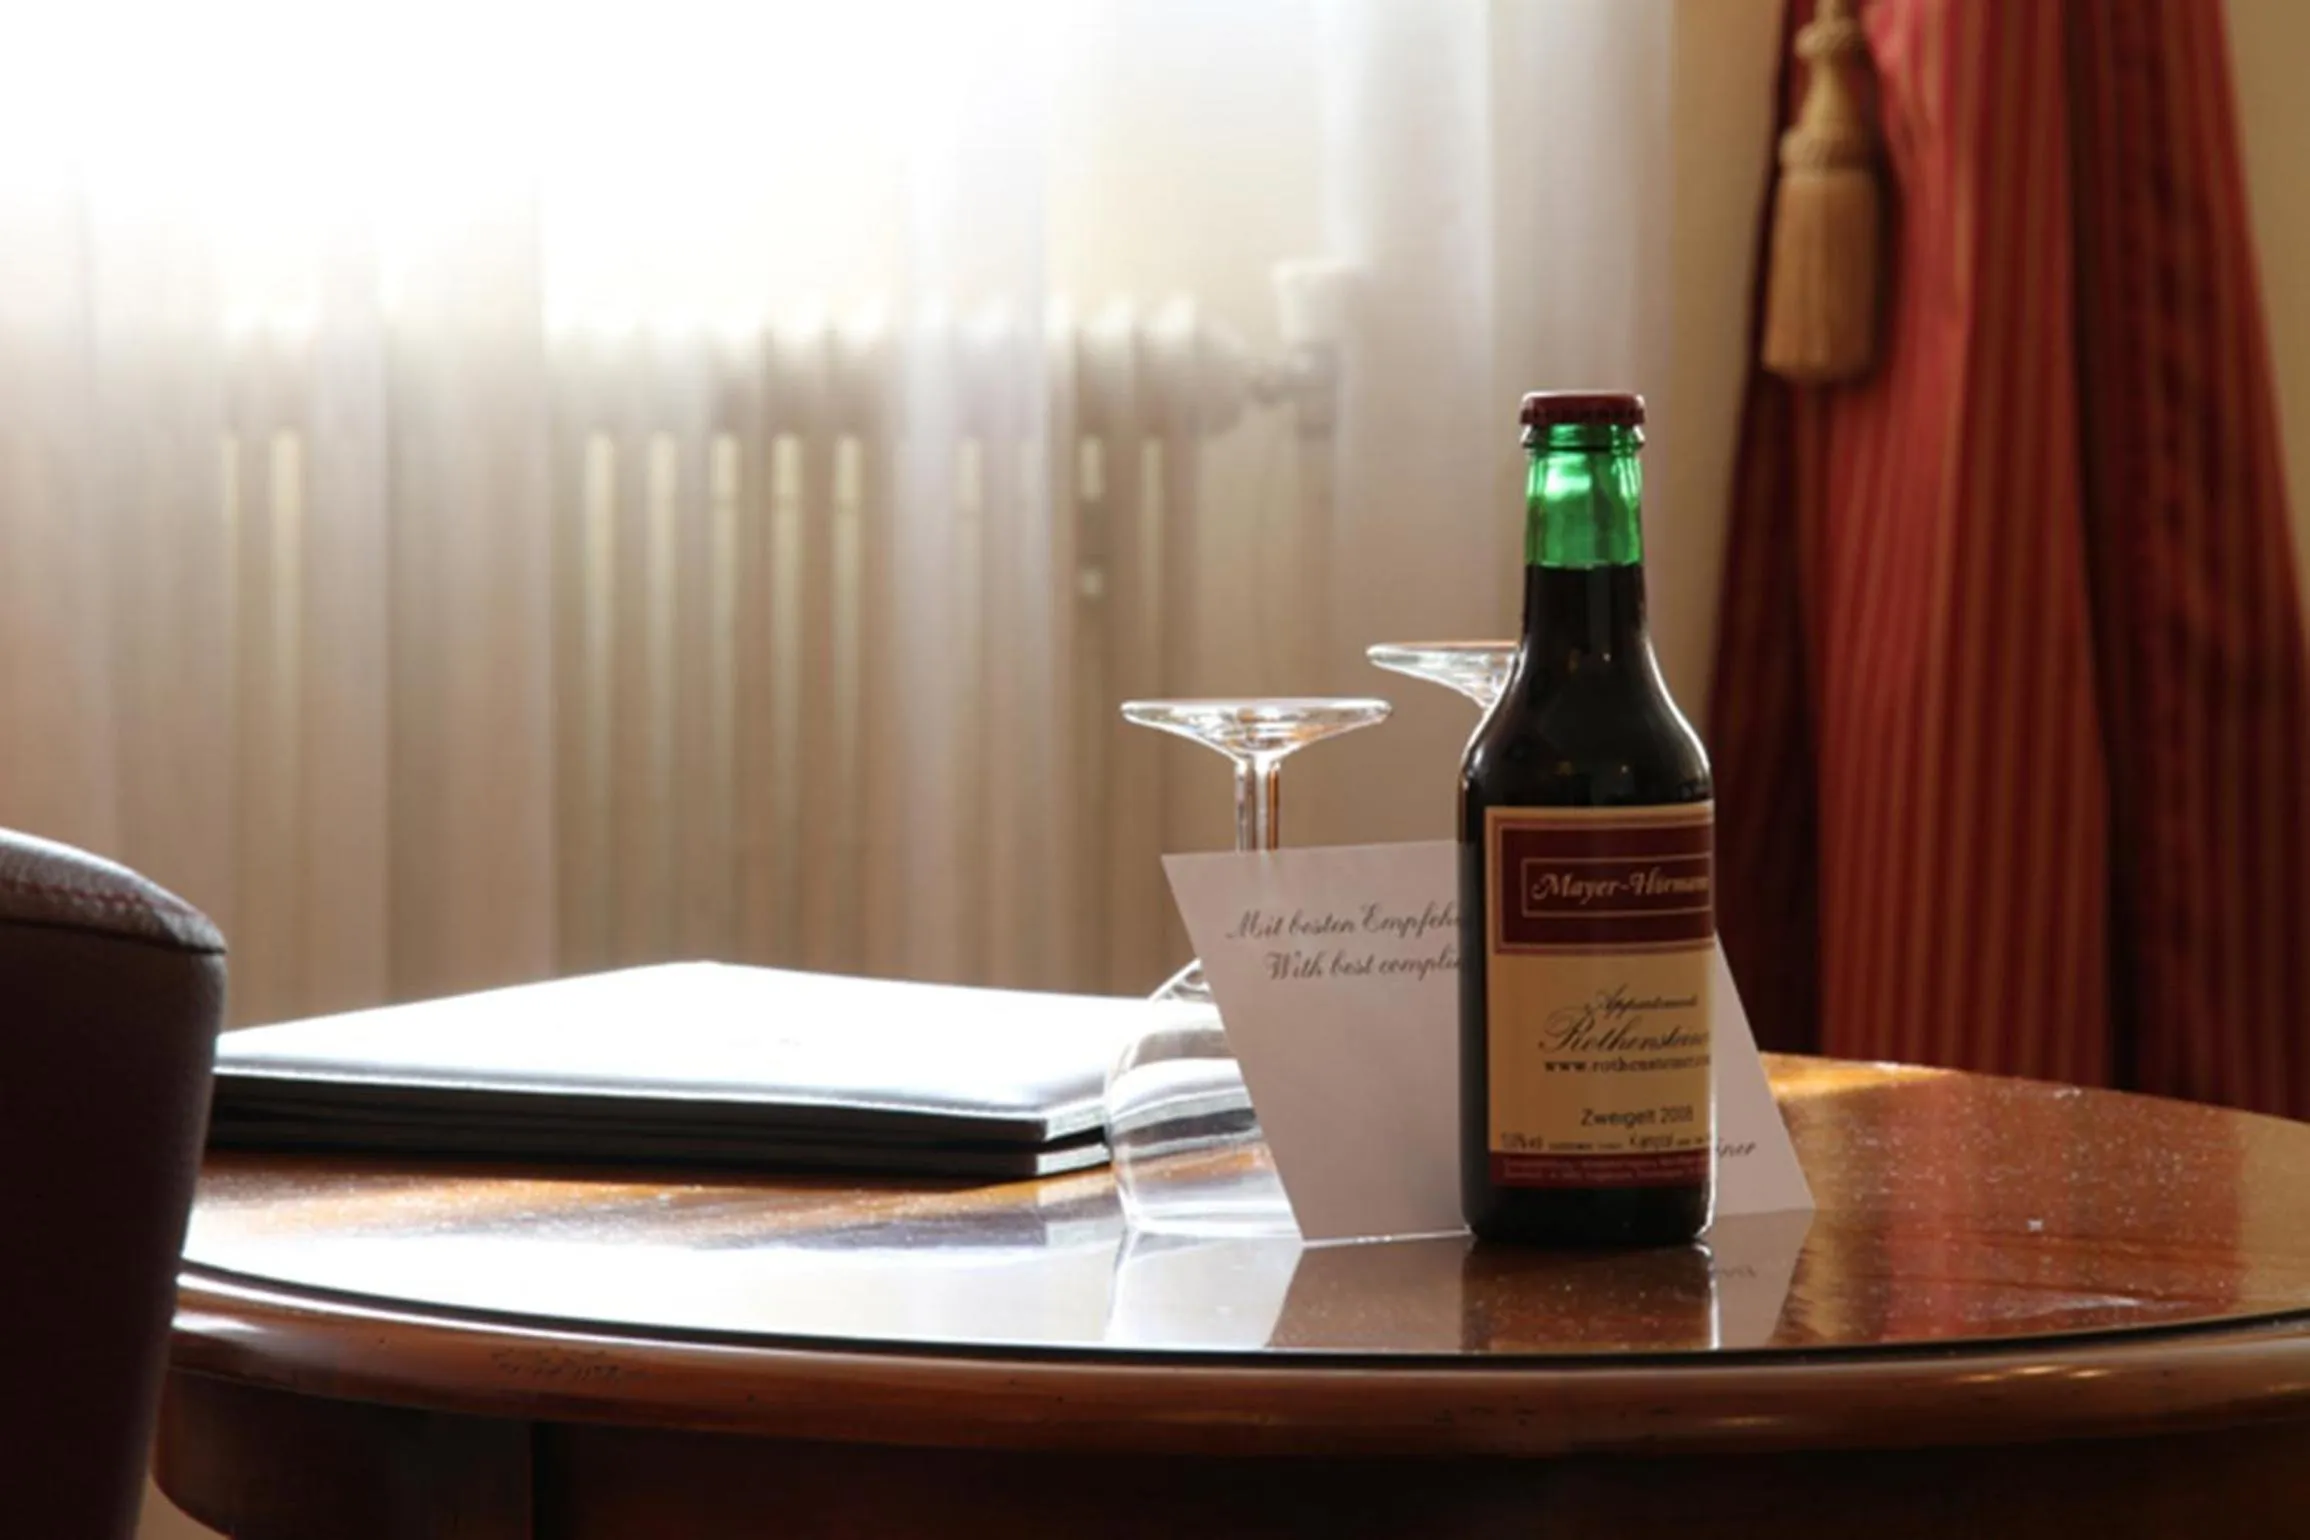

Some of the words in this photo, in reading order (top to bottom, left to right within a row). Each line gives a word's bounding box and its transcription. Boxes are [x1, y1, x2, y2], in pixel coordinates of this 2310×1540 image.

[1225, 909, 1285, 940] Mit
[1288, 908, 1356, 938] besten
[1266, 951, 1322, 981] With
[1330, 949, 1375, 978] best
